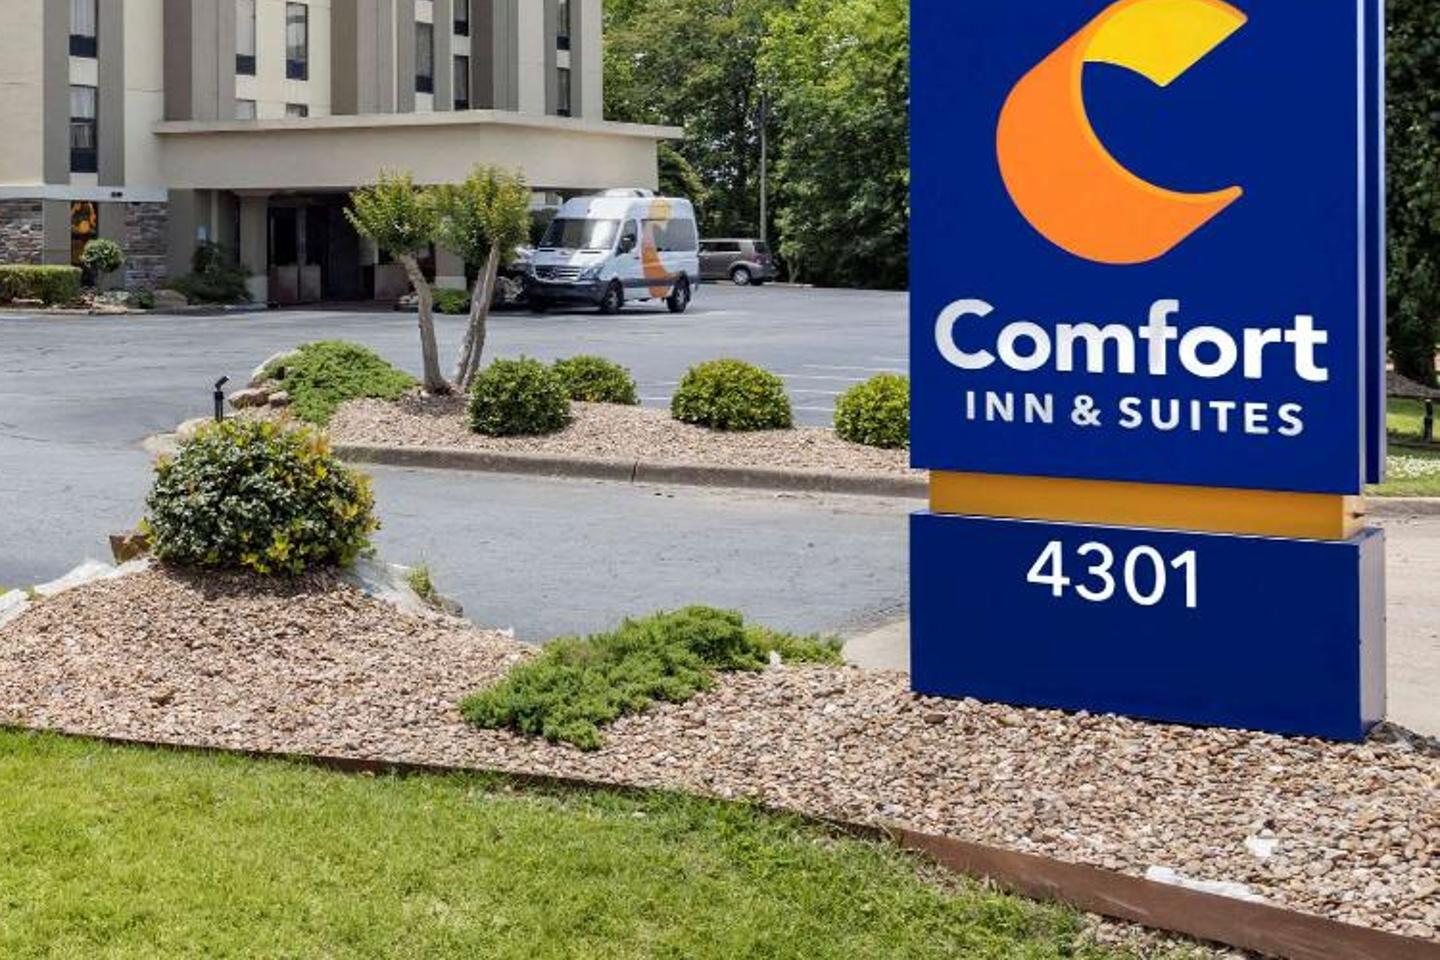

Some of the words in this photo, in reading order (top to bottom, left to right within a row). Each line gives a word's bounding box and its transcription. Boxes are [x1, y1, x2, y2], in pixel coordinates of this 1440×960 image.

[934, 298, 1329, 382] Comfort
[966, 390, 1054, 425] INN
[1071, 395, 1102, 427] &
[1119, 397, 1304, 437] SUITES
[1026, 541, 1198, 608] 4301
